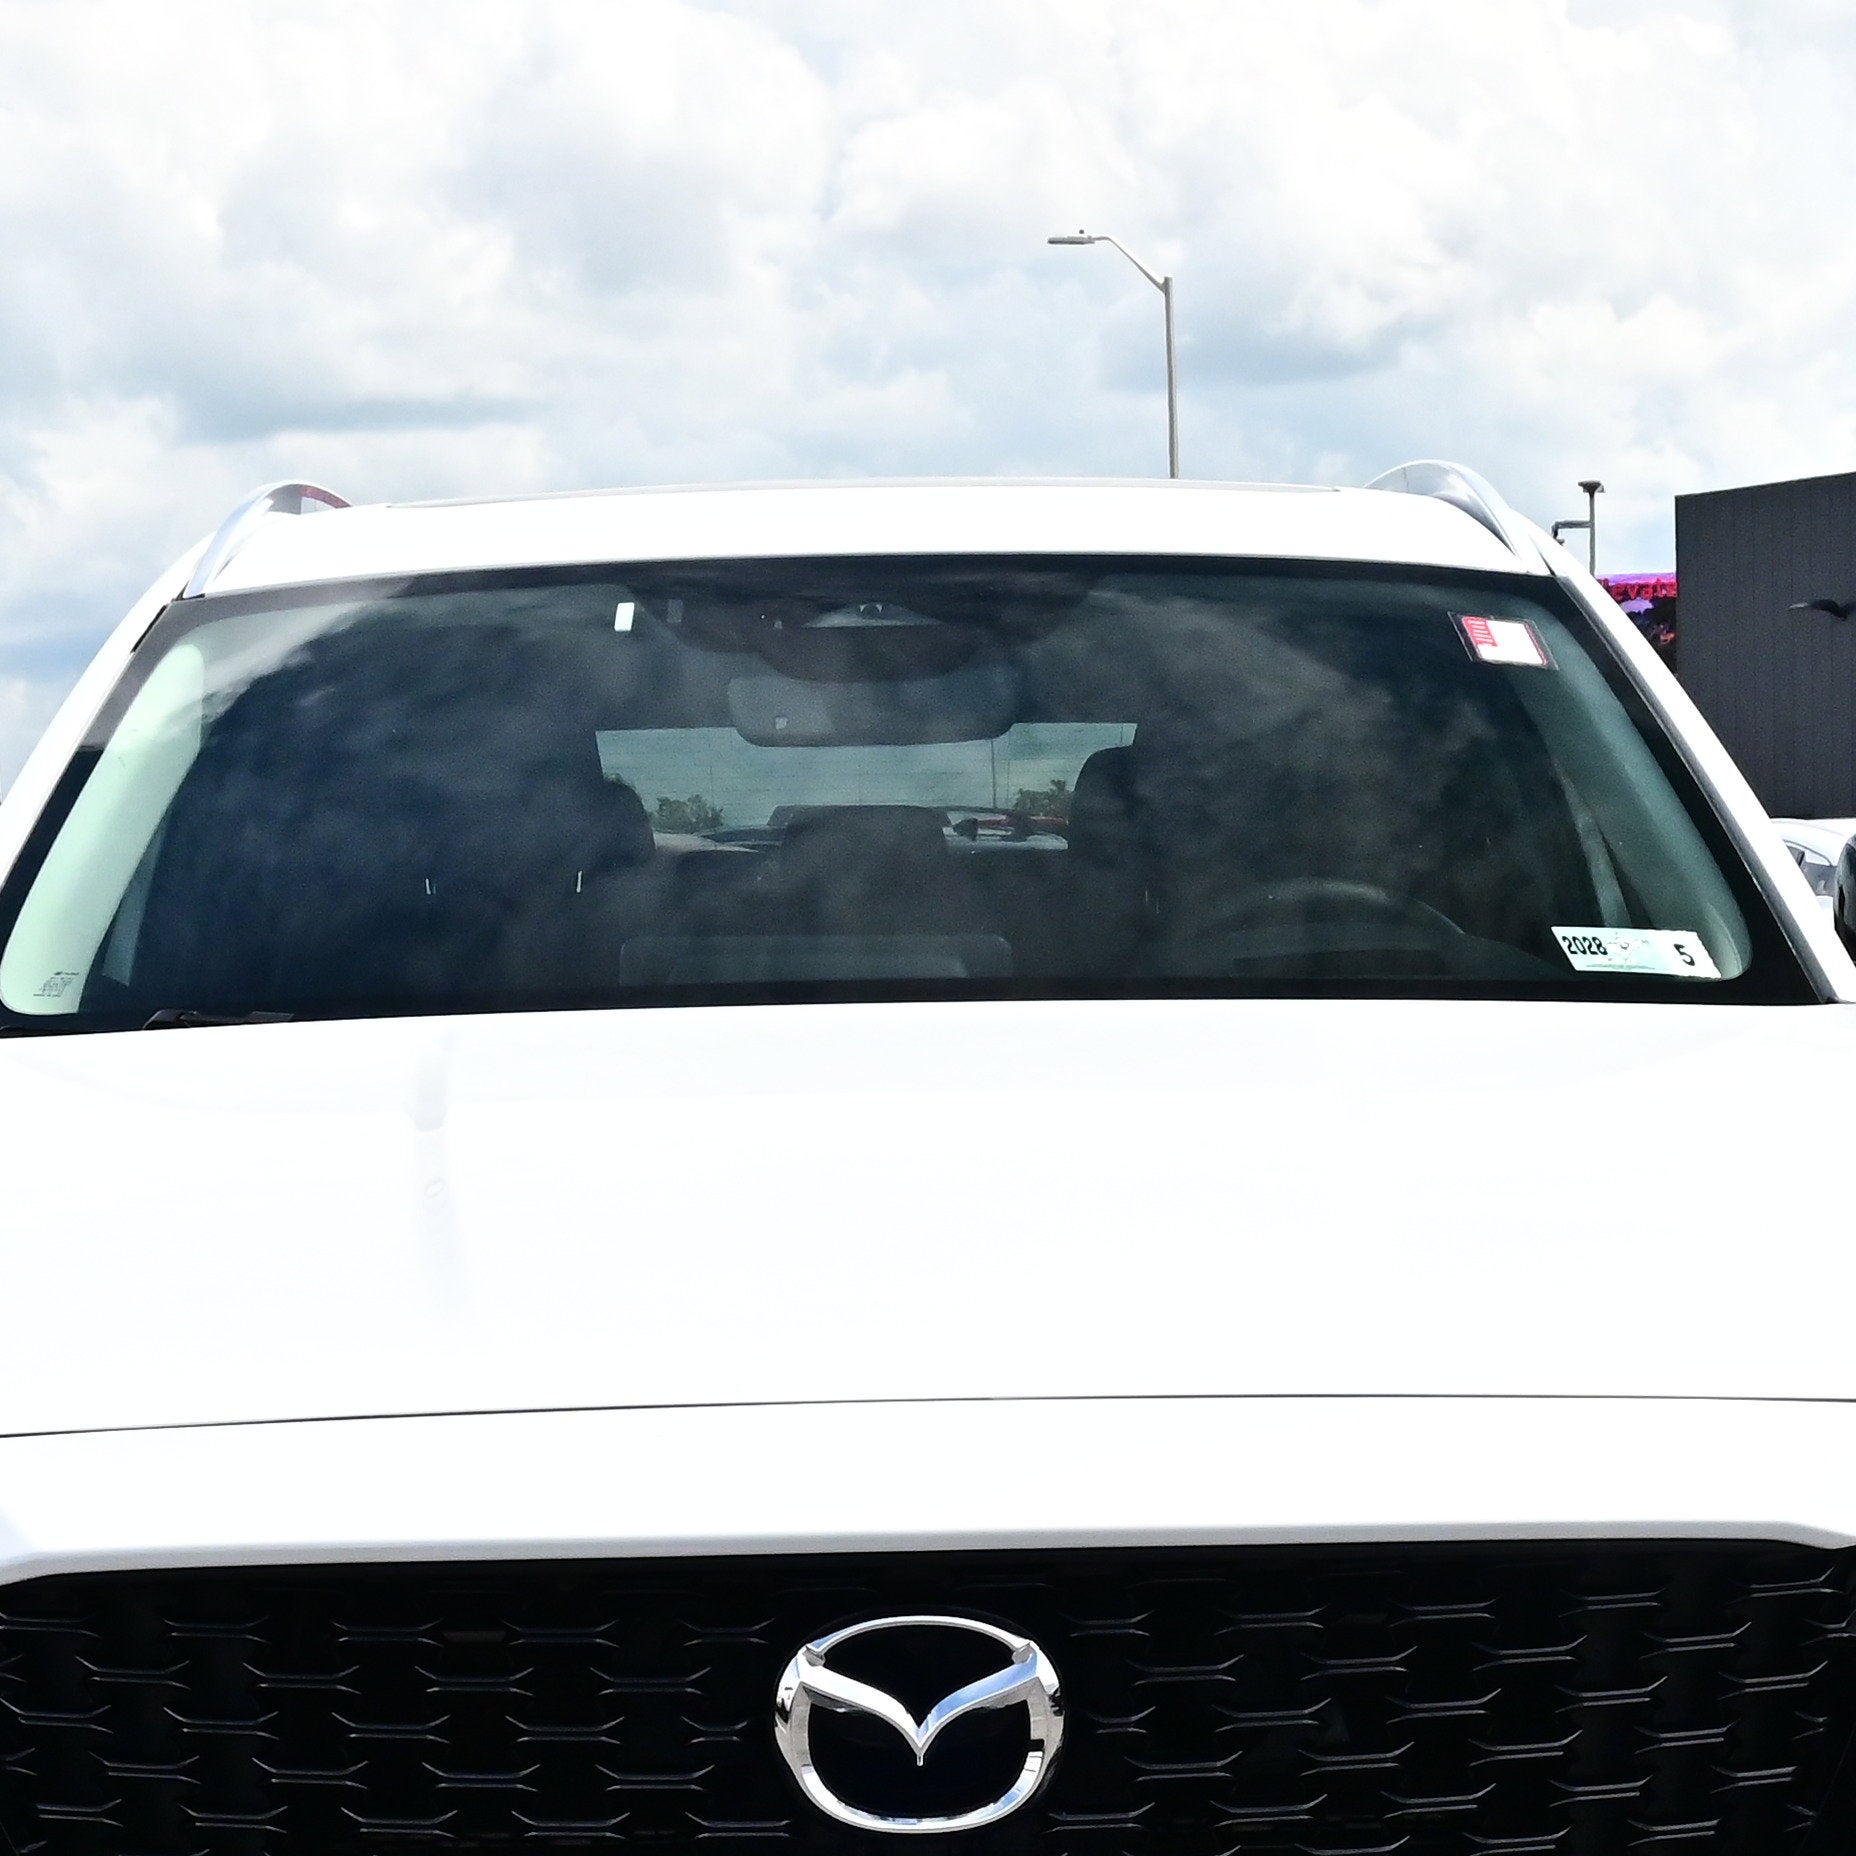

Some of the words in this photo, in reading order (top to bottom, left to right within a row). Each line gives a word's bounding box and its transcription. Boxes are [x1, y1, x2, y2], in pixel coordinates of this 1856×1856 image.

[1602, 578, 1678, 602] evate
[1561, 935, 1609, 956] 2028
[1673, 943, 1696, 967] 5
